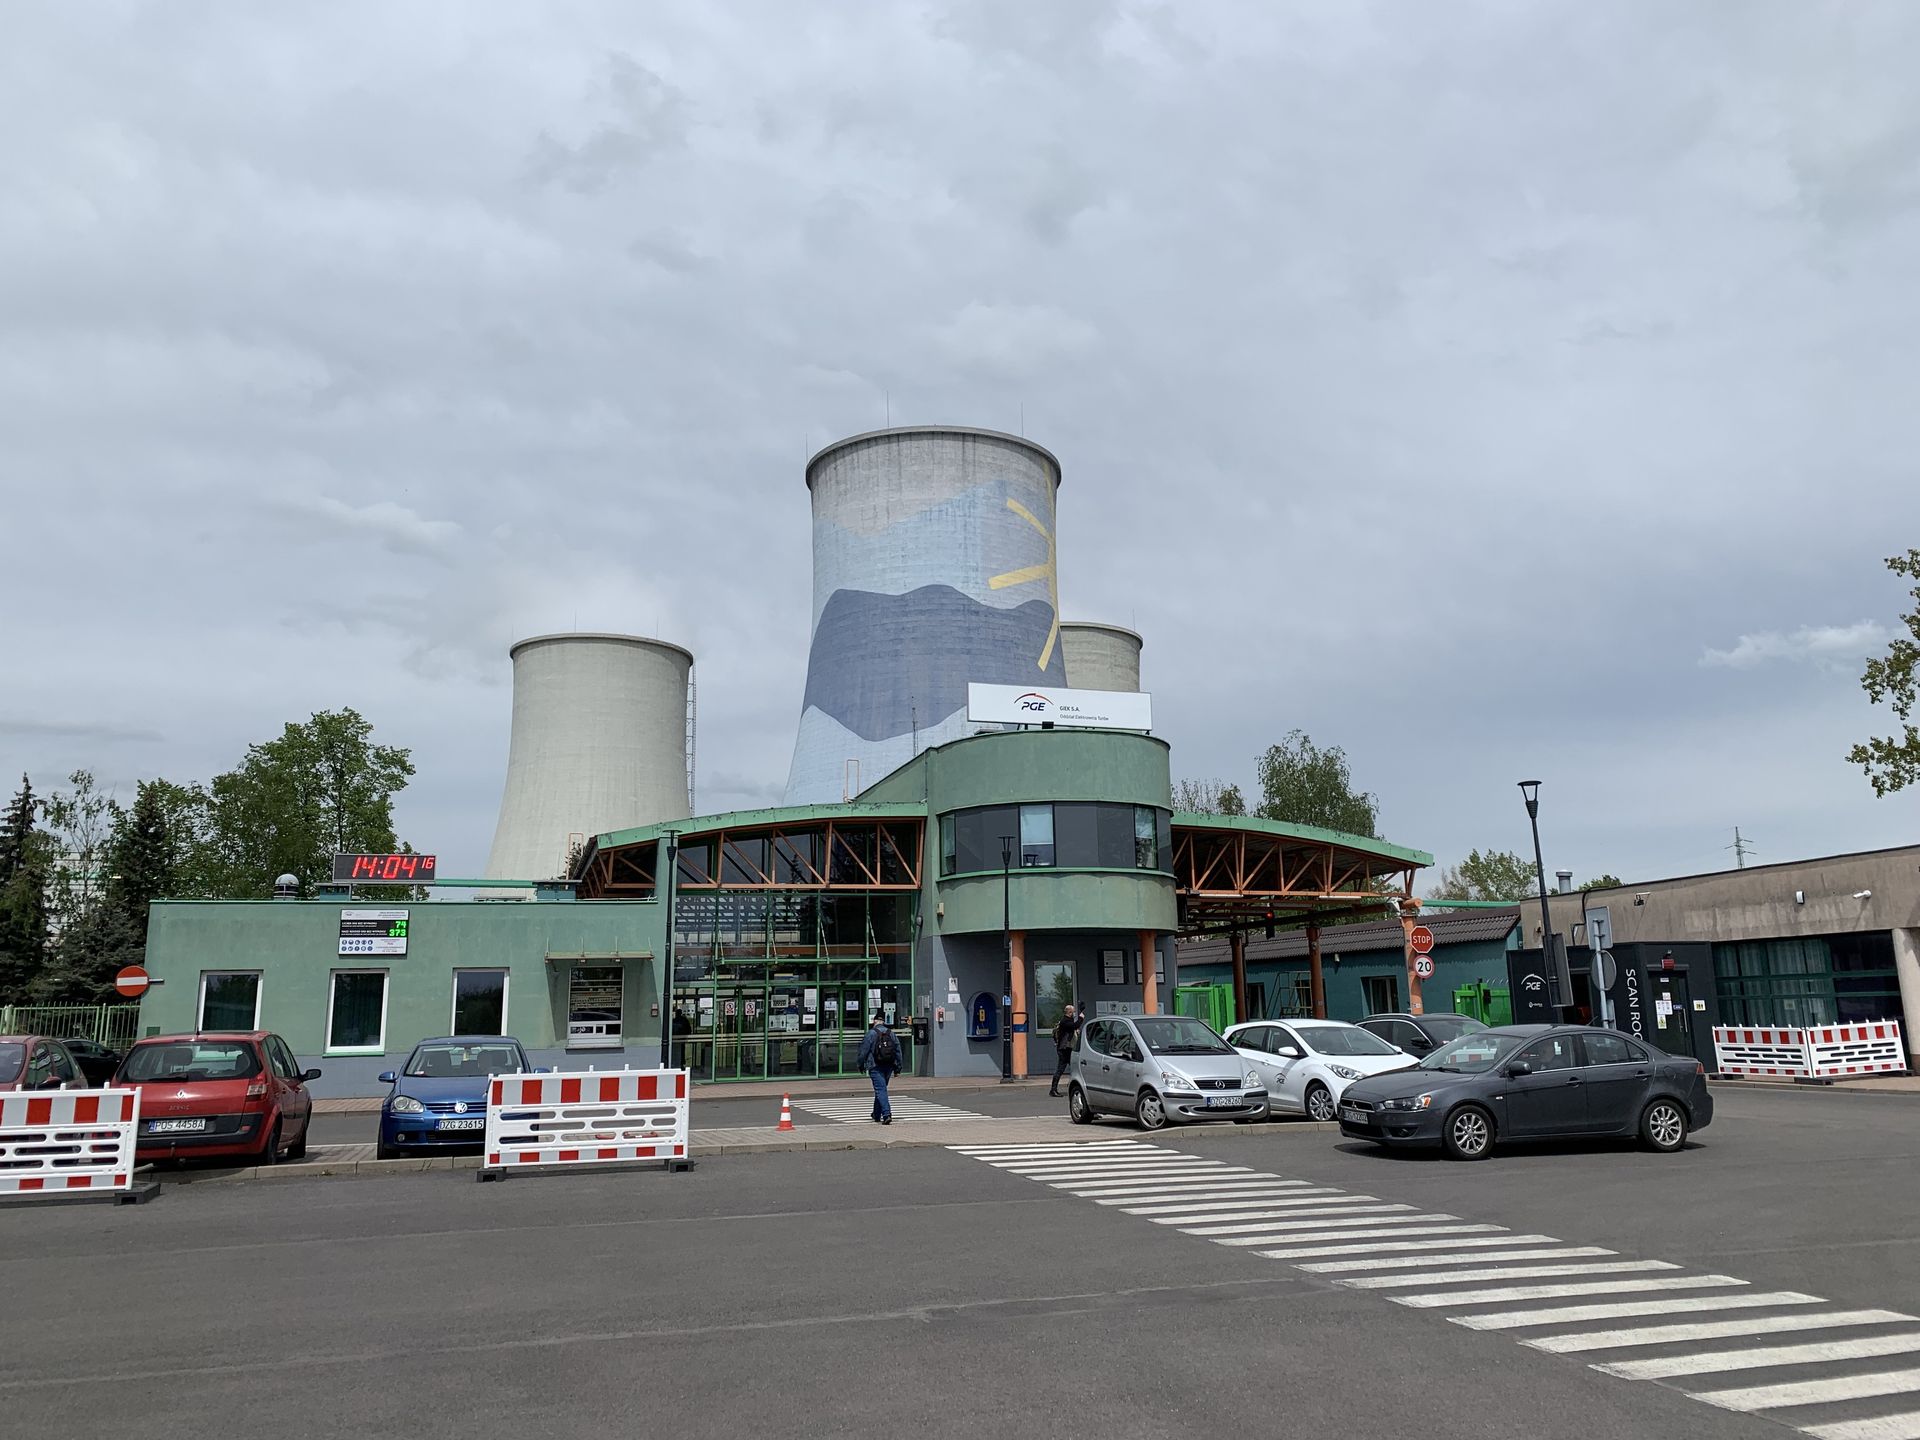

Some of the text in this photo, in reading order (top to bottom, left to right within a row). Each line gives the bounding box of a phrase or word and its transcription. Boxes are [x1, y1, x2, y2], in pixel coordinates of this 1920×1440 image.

[1021, 701, 1046, 711] PGE
[351, 856, 435, 879] 14:04 16
[395, 920, 407, 929] 74
[389, 929, 406, 937] 373
[1412, 935, 1431, 944] STOP
[1417, 961, 1432, 972] 20
[1525, 981, 1541, 990] PGE
[1625, 968, 1640, 1008] SCAN
[175, 1119, 204, 1130] 4458A
[439, 1120, 484, 1130] DZG 23615
